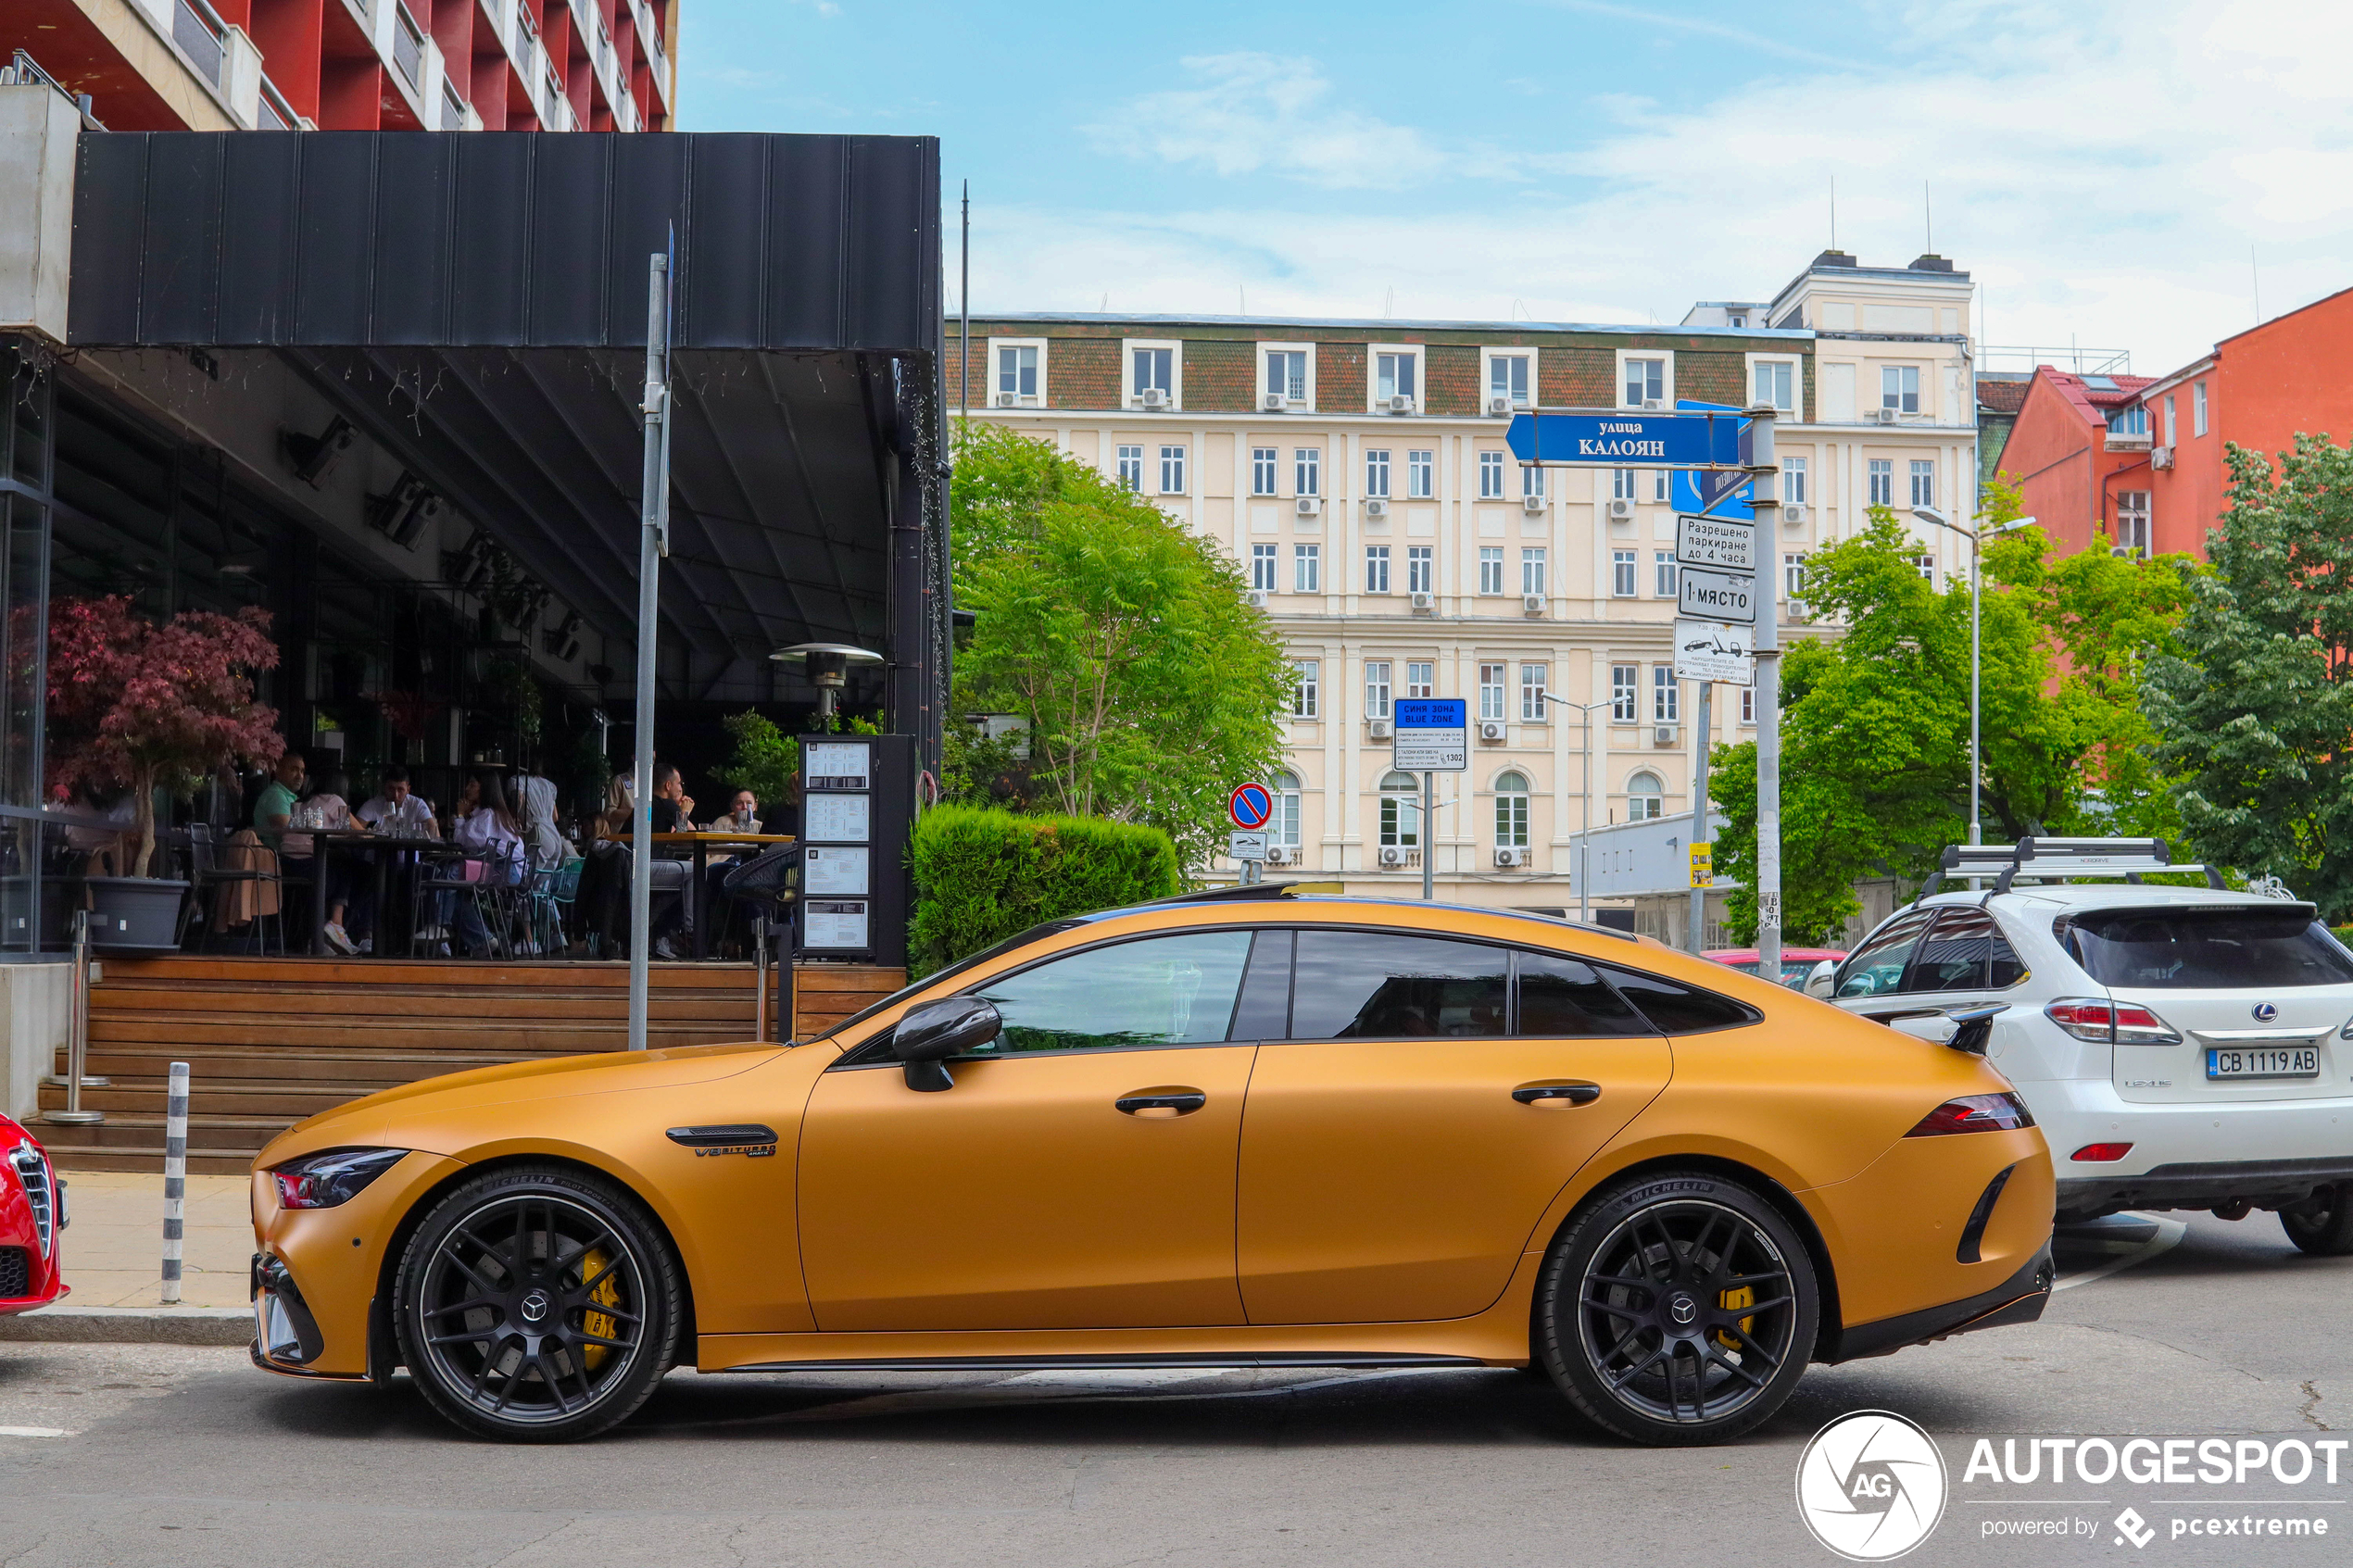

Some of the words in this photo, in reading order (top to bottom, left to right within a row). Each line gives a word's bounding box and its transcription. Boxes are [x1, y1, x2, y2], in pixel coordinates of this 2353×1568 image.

[1599, 422, 1642, 436] улица
[1579, 439, 1666, 457] КАЛОЯН
[1688, 521, 1748, 538] Разрешено
[1689, 536, 1746, 551] паркиране
[1688, 550, 1701, 559] до
[1707, 549, 1715, 559] 4
[1720, 554, 1745, 563] часа
[1697, 587, 1747, 608] МЯСТО
[1691, 656, 1727, 664] НАРУШИТЕЛИТЕ
[1446, 753, 1463, 761] 1302
[2220, 1053, 2242, 1073] CB
[2247, 1051, 2289, 1072] 1119
[2293, 1051, 2315, 1071] AB
[2125, 1079, 2171, 1088] LEXUS
[481, 1174, 556, 1194] MICHELIN
[1630, 1182, 1711, 1203] MICHELIN
